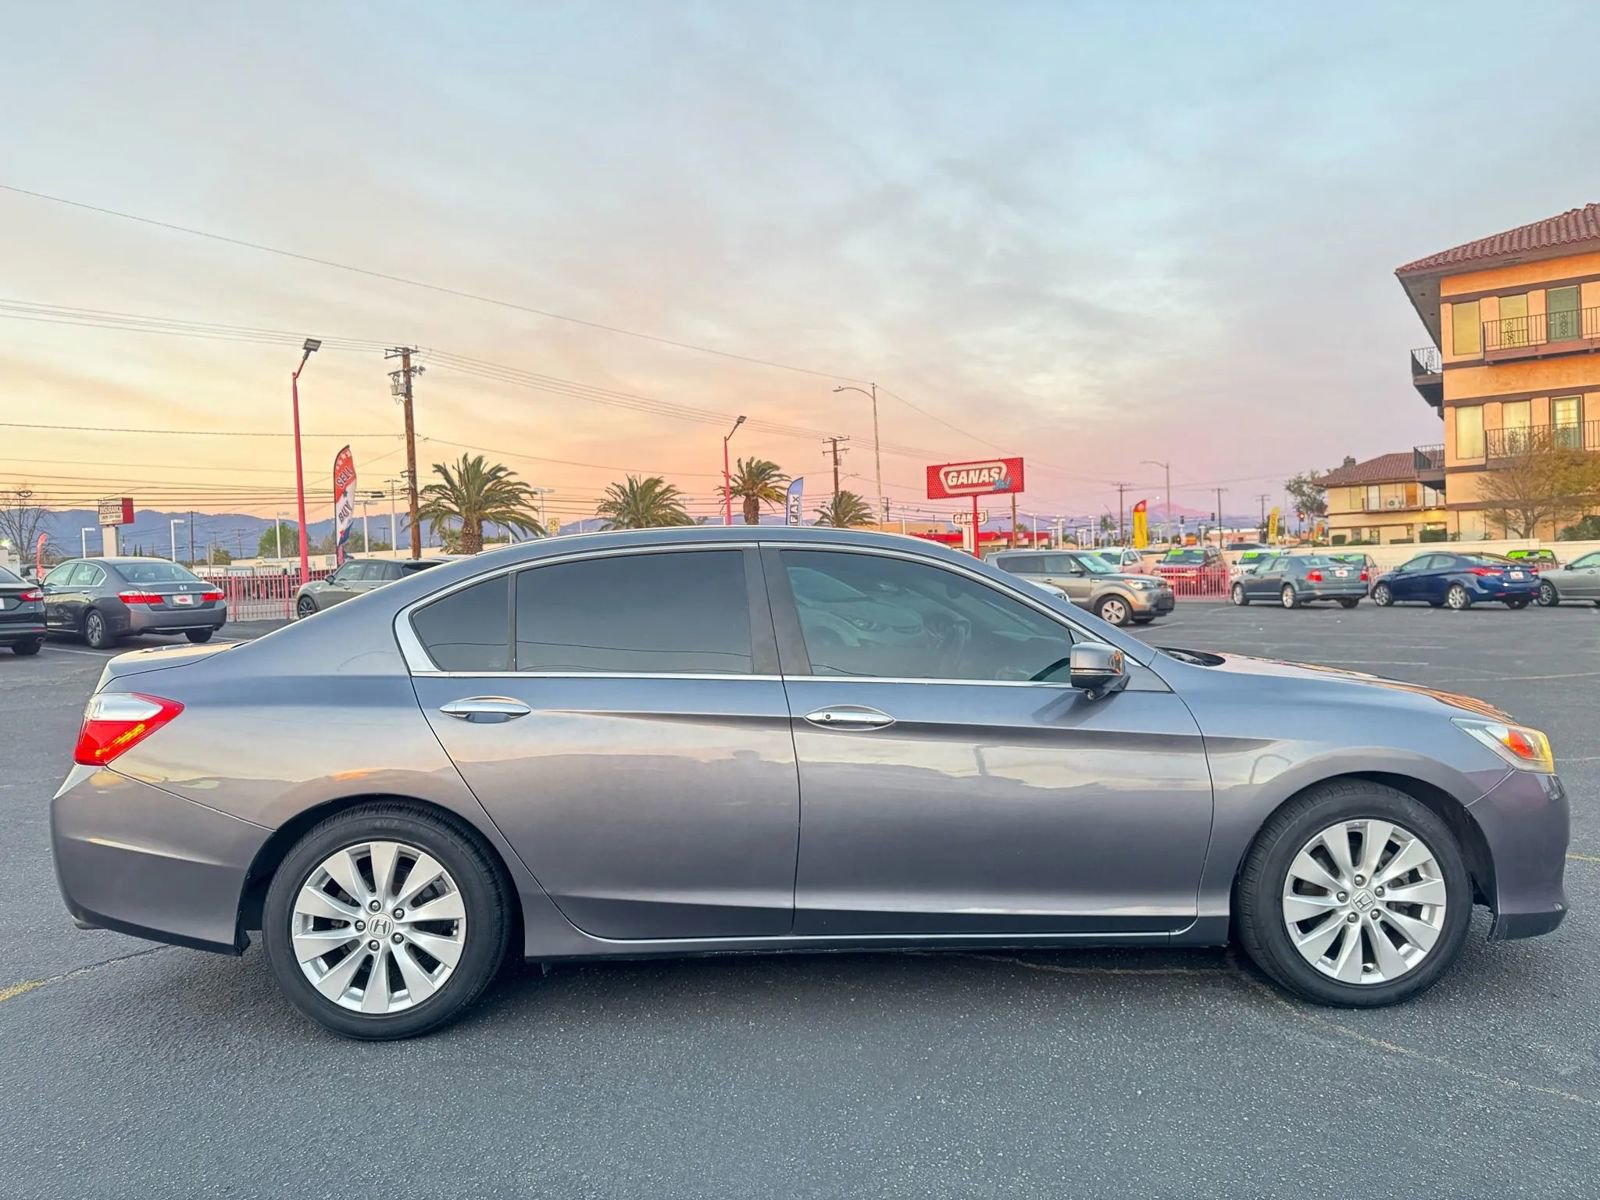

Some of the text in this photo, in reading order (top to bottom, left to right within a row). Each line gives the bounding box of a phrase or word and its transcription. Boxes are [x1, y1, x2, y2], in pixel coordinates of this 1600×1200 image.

[336, 467, 353, 488] SELL
[947, 467, 1001, 486] GANAS
[338, 500, 353, 523] BUY
[790, 495, 800, 524] FAX
